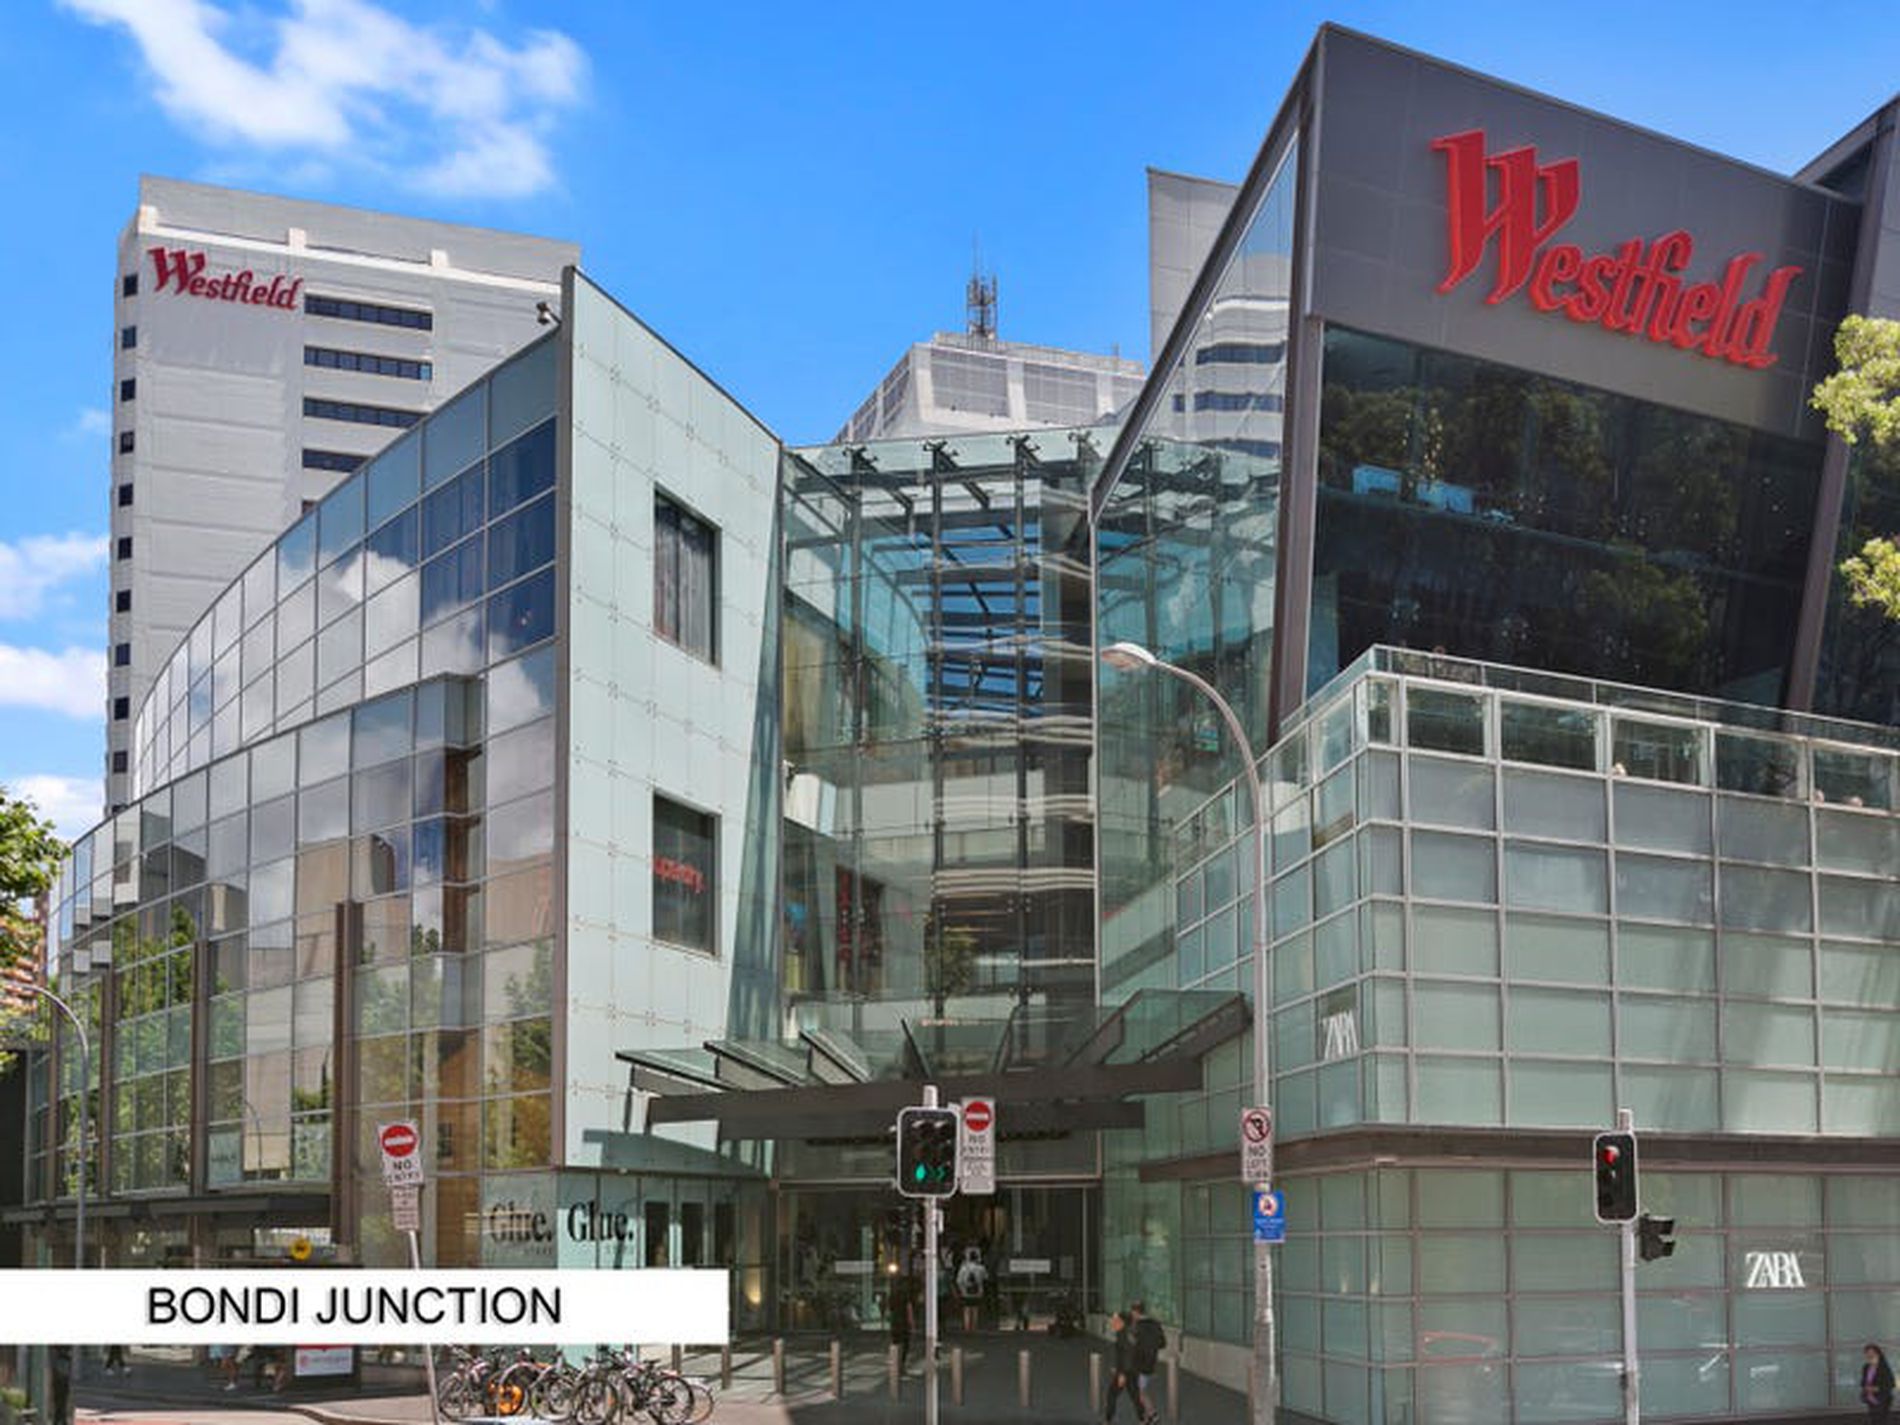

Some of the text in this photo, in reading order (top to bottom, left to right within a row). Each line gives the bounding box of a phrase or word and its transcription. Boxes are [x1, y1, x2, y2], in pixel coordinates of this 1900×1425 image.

[1431, 128, 1803, 369] Westfield
[147, 246, 304, 311] Westfield
[393, 1159, 412, 1171] NO
[1248, 1145, 1267, 1157] NO
[490, 1201, 552, 1242] Glue.
[567, 1201, 634, 1242] Glue.
